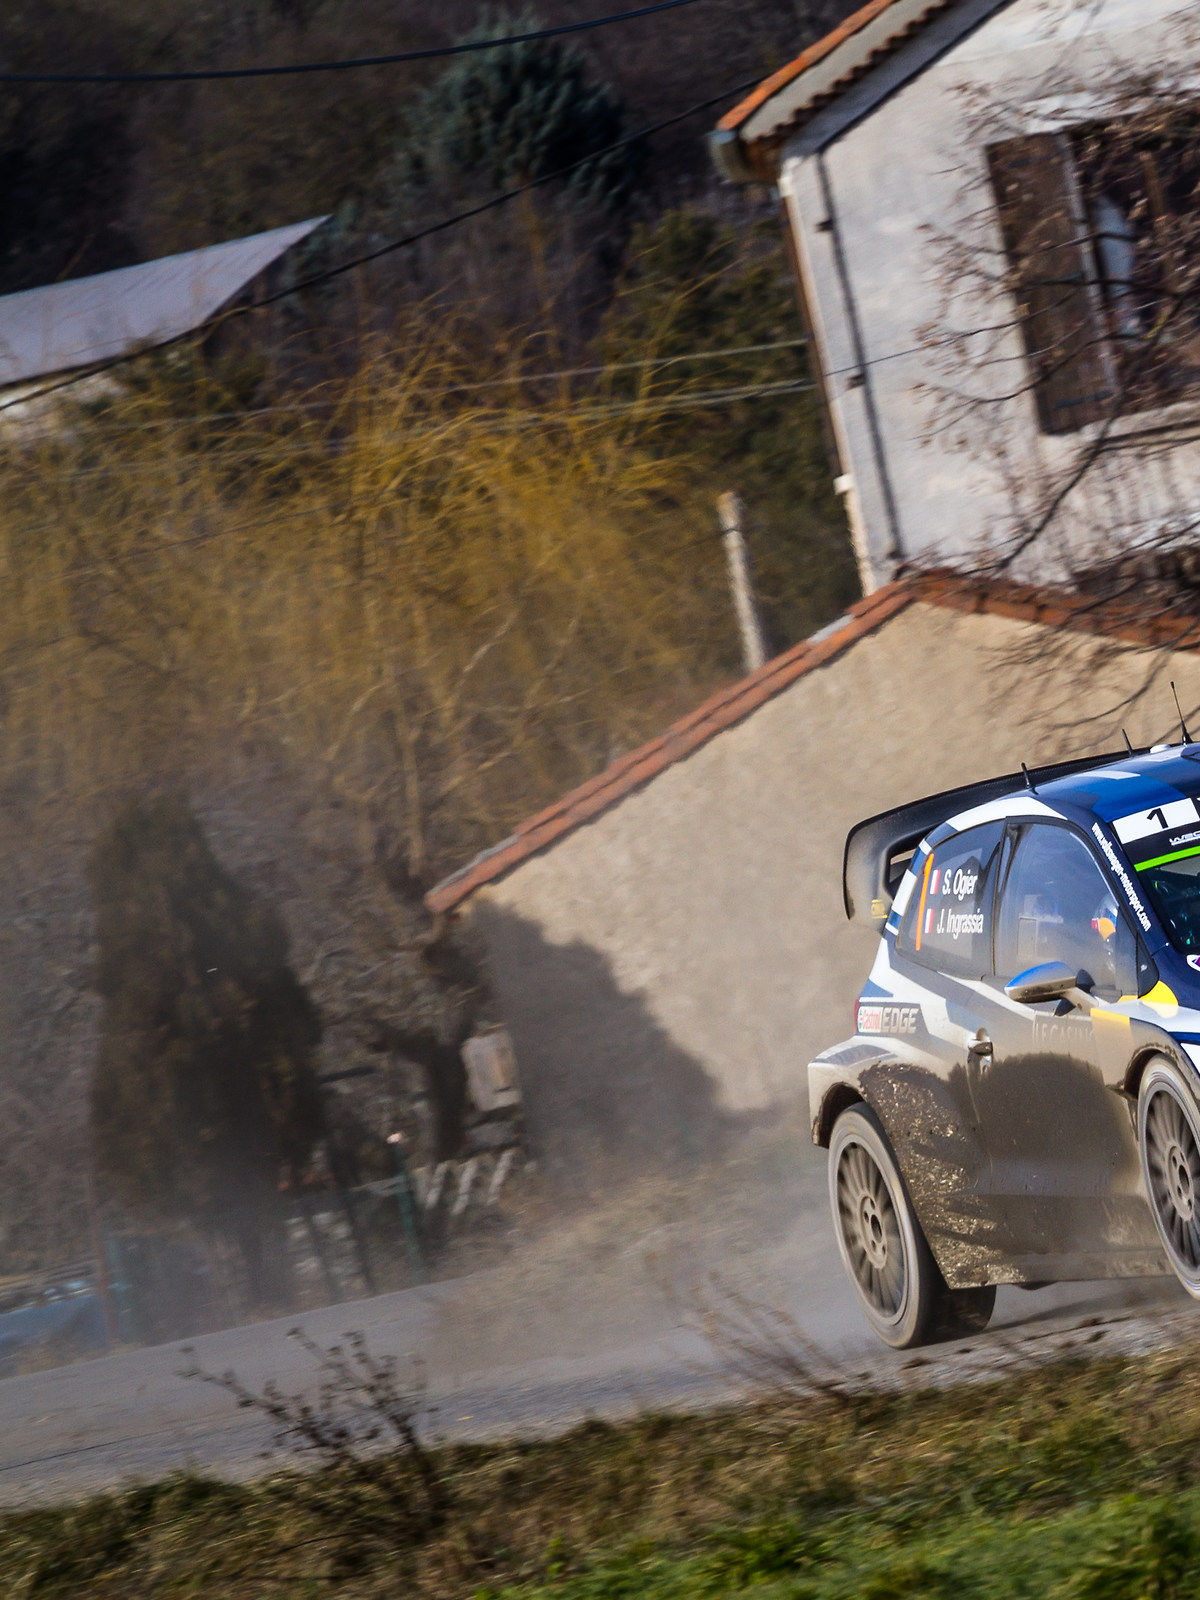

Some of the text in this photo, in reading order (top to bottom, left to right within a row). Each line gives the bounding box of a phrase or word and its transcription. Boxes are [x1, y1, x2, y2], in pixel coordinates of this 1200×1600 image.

[1146, 807, 1169, 829] 1
[942, 868, 978, 901] S. Ogier
[1091, 822, 1152, 932] www.volkswagen-motorsport.com
[936, 907, 985, 940] J. Ingrassia
[882, 1007, 920, 1034] EDGE
